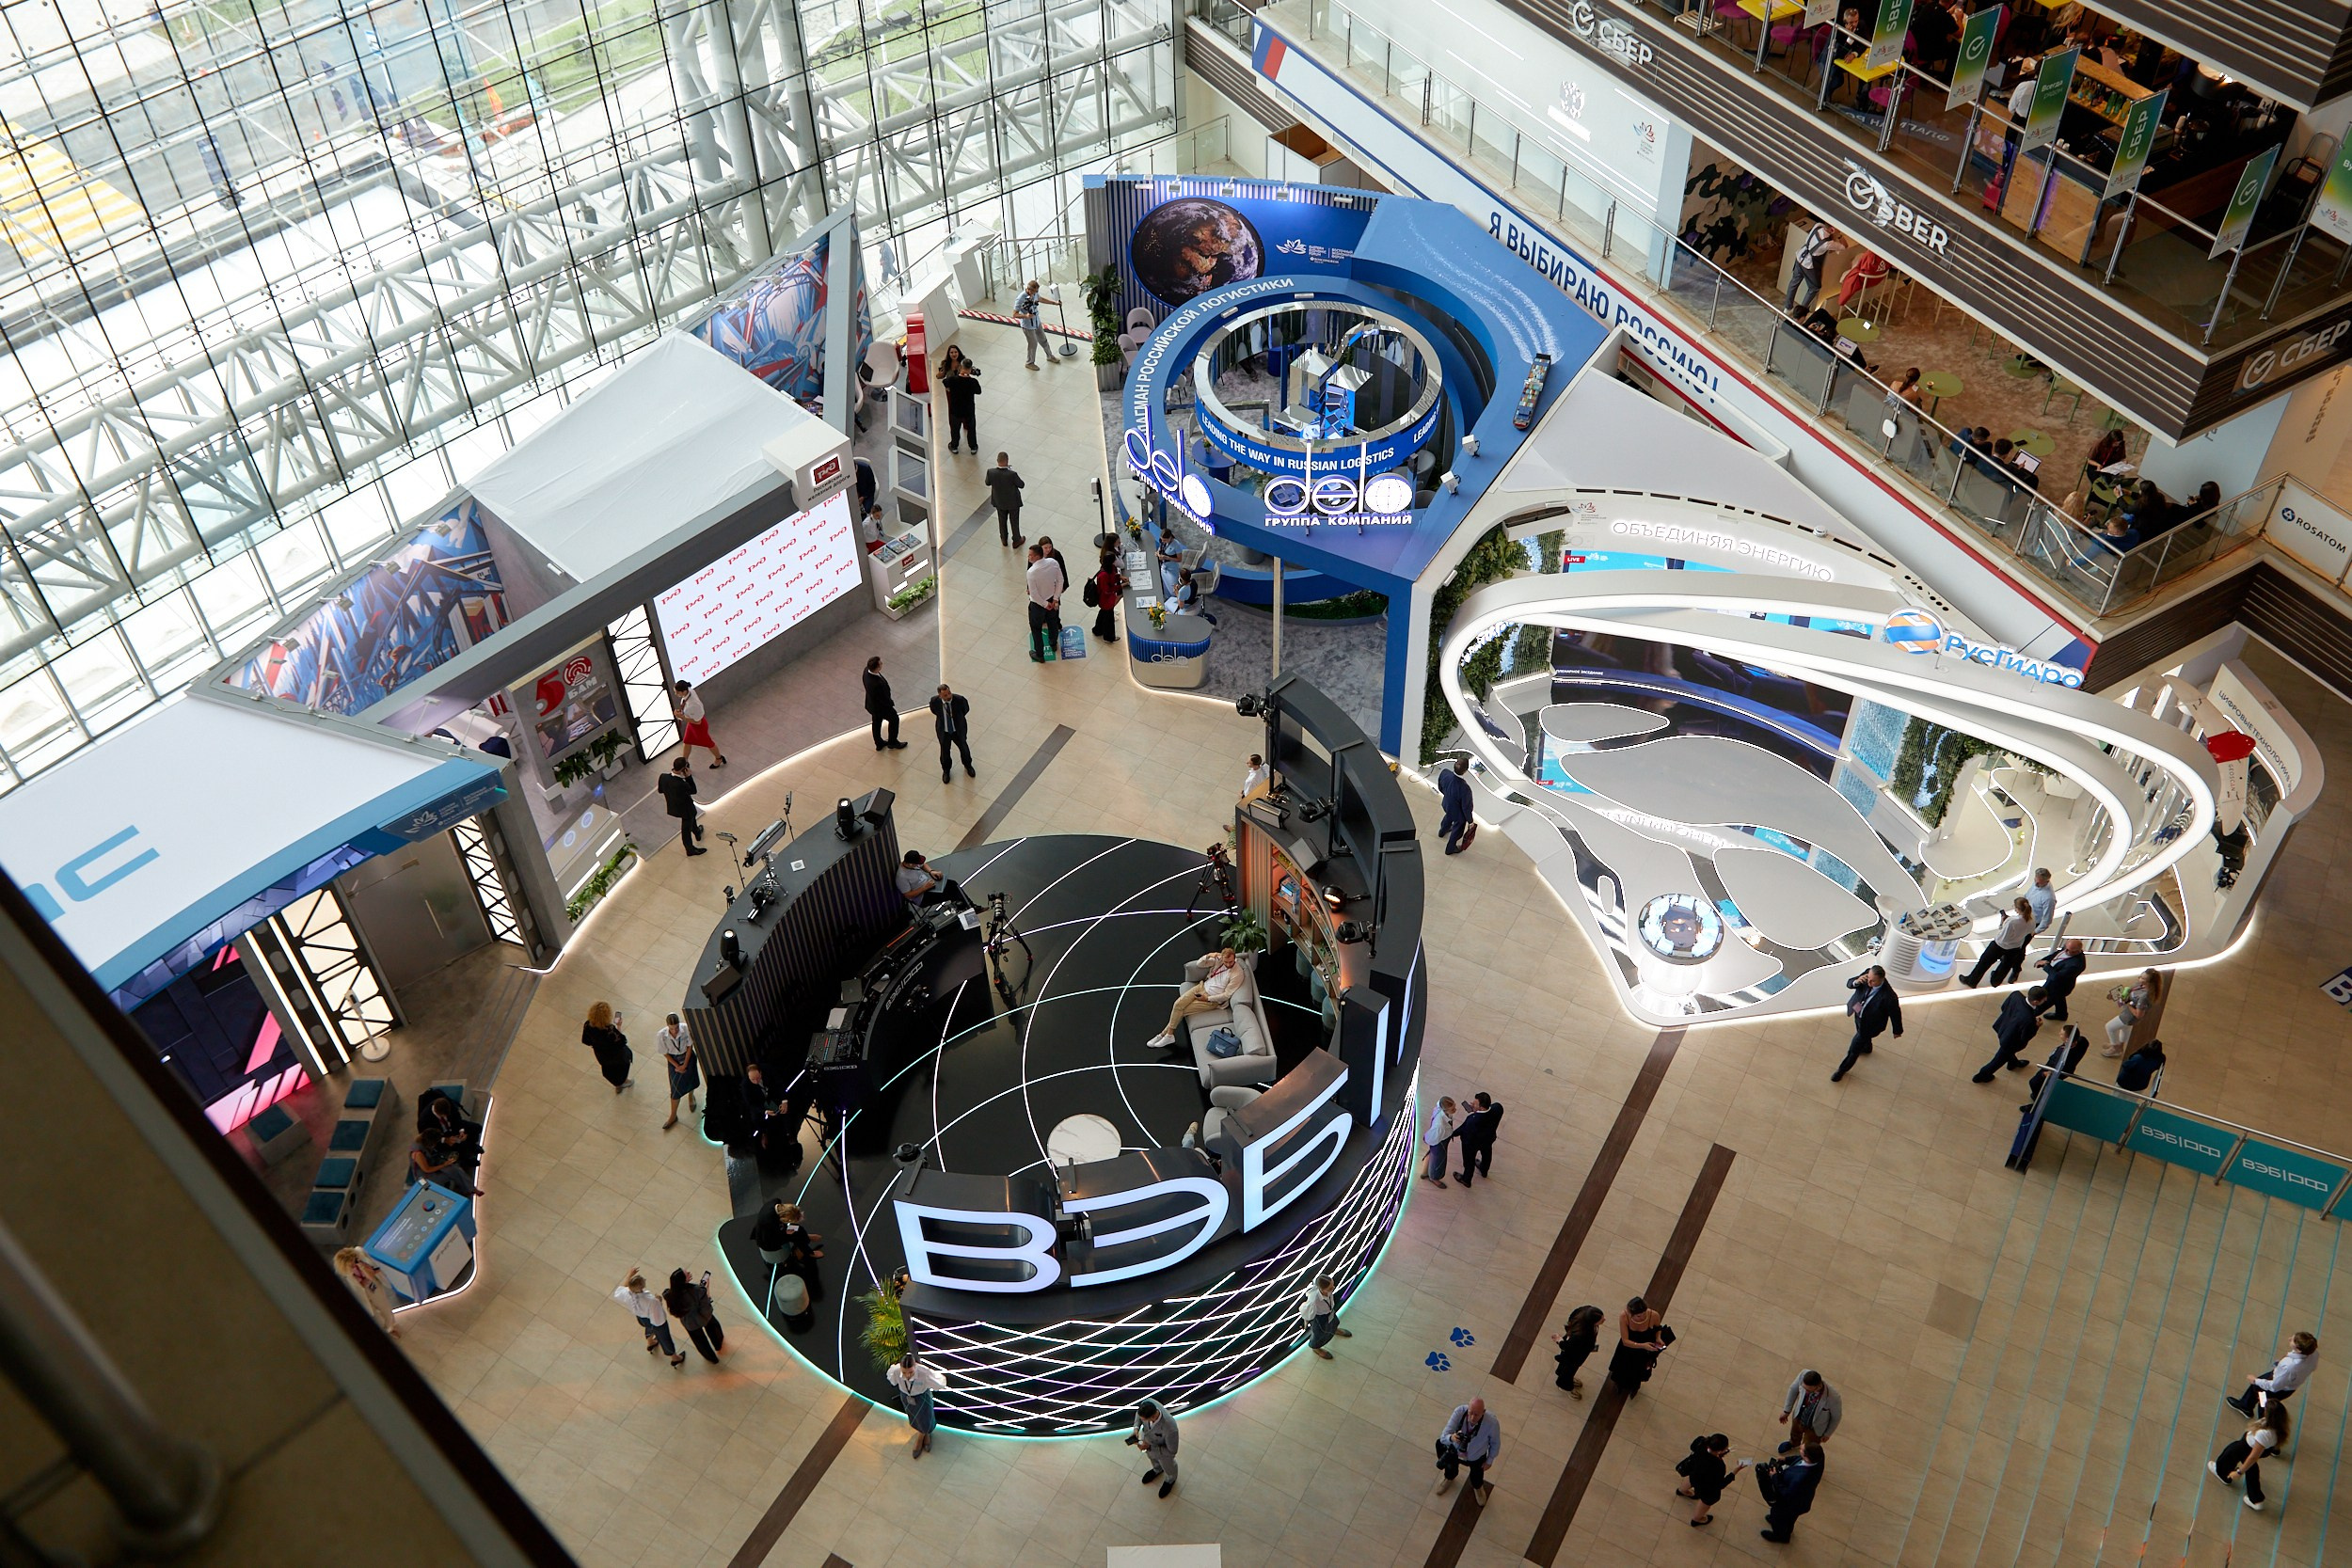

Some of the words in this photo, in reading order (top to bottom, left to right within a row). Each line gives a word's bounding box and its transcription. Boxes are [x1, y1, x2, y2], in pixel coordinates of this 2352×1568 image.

[1599, 22, 1653, 65] СБЕР
[2127, 110, 2149, 159] СБЕР
[1880, 195, 1949, 255] SBER
[1488, 212, 1502, 240] Я
[1506, 222, 1610, 320] ВЫБИРАЮ
[1136, 309, 1200, 383] РОССИЙСКОЙ
[1198, 277, 1295, 313] ЛОГИСТИКИ
[2280, 320, 2351, 367] СБЕР
[1202, 412, 1228, 444] LEADING
[1228, 437, 1247, 455] THE
[1248, 447, 1271, 466] WAY
[1273, 454, 1285, 467] IN
[1287, 458, 1339, 471] RUSSIAN
[1340, 447, 1394, 469] LOGSTICS
[1126, 460, 1160, 493] ГРУППА
[1161, 490, 1215, 536] КОМПАНИЙ
[1264, 517, 1321, 527] ГРУППА
[1327, 515, 1413, 527] КОМПАНИЙ
[1613, 522, 1733, 550] ОБЪЕДИНЯЯ
[1739, 542, 1832, 583] ЭНЕРГИЮ
[2296, 516, 2346, 554] ROSATOM
[1945, 635, 2082, 689] РусГидро
[567, 676, 598, 700] БАМ
[2218, 689, 2254, 733] ЦИФРОВЫЕ
[2228, 764, 2236, 792] GEOSCAN
